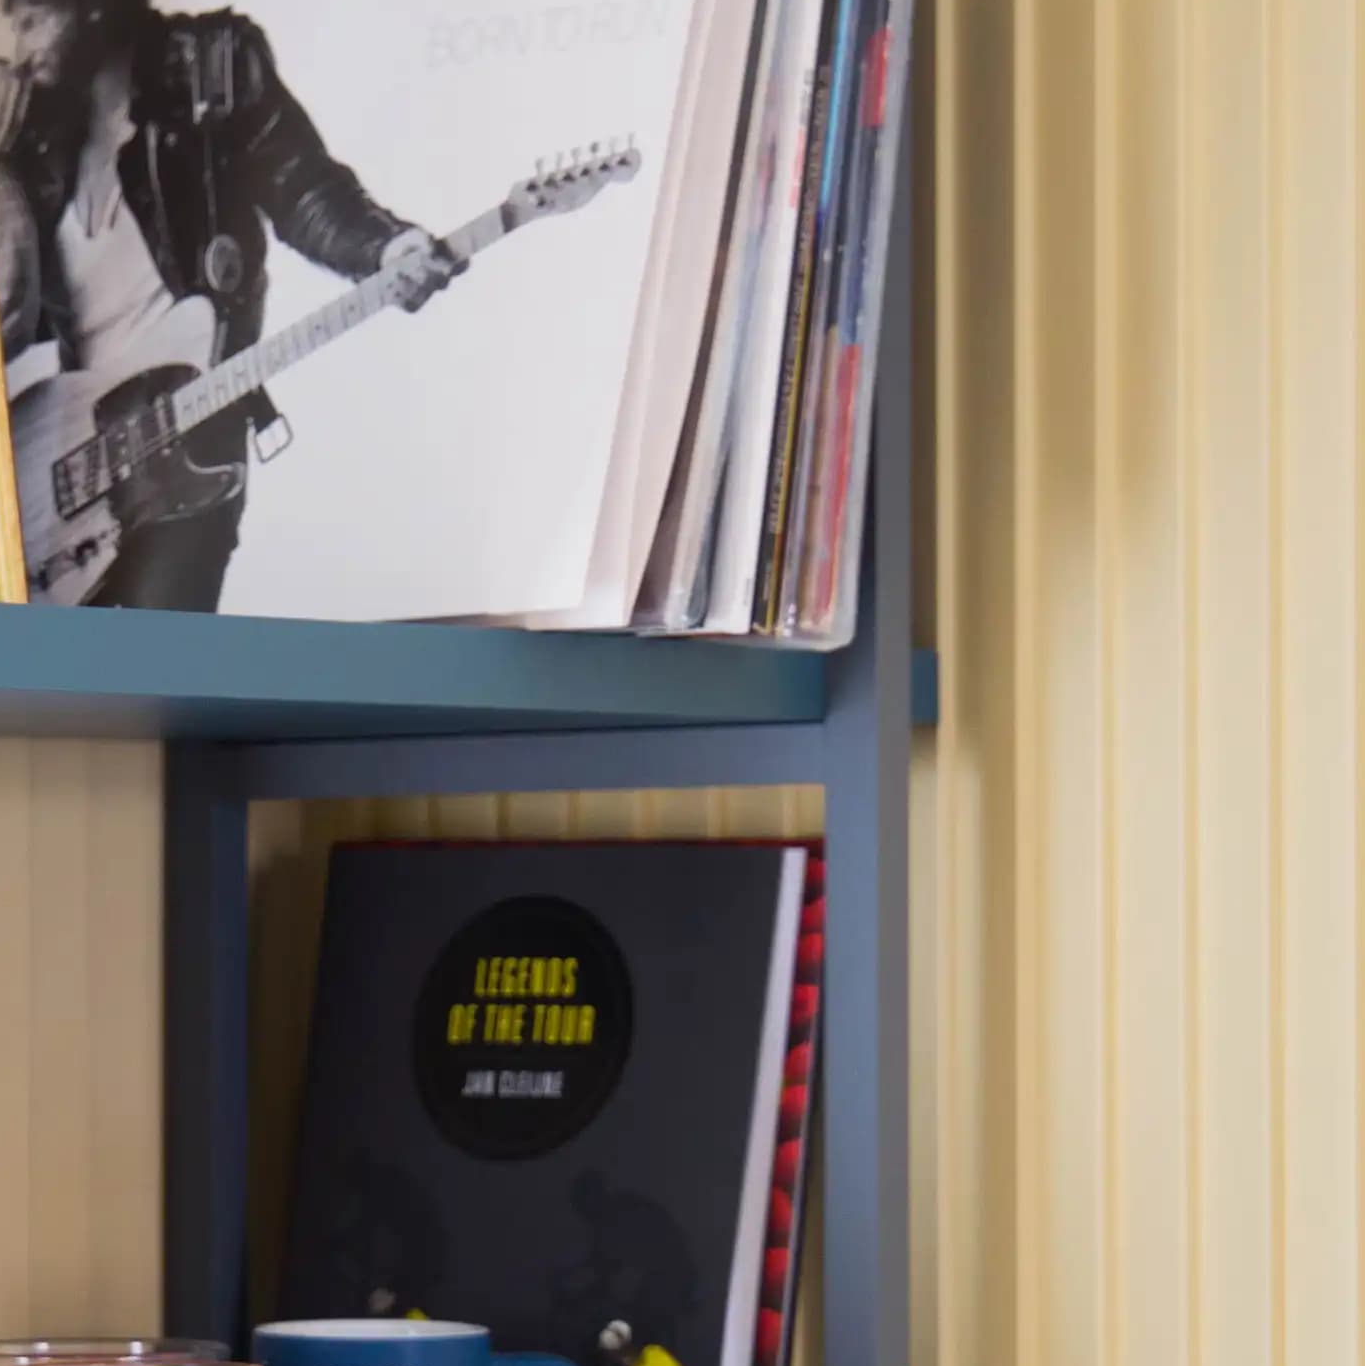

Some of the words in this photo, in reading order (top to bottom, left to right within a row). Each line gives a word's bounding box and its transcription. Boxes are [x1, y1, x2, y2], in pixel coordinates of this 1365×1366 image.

[427, 15, 530, 68] BORN
[545, 9, 587, 53] TO
[474, 957, 578, 997] LEGENDS
[447, 1004, 479, 1045] OF
[483, 1004, 527, 1044] THE
[532, 1004, 596, 1045] TOUR
